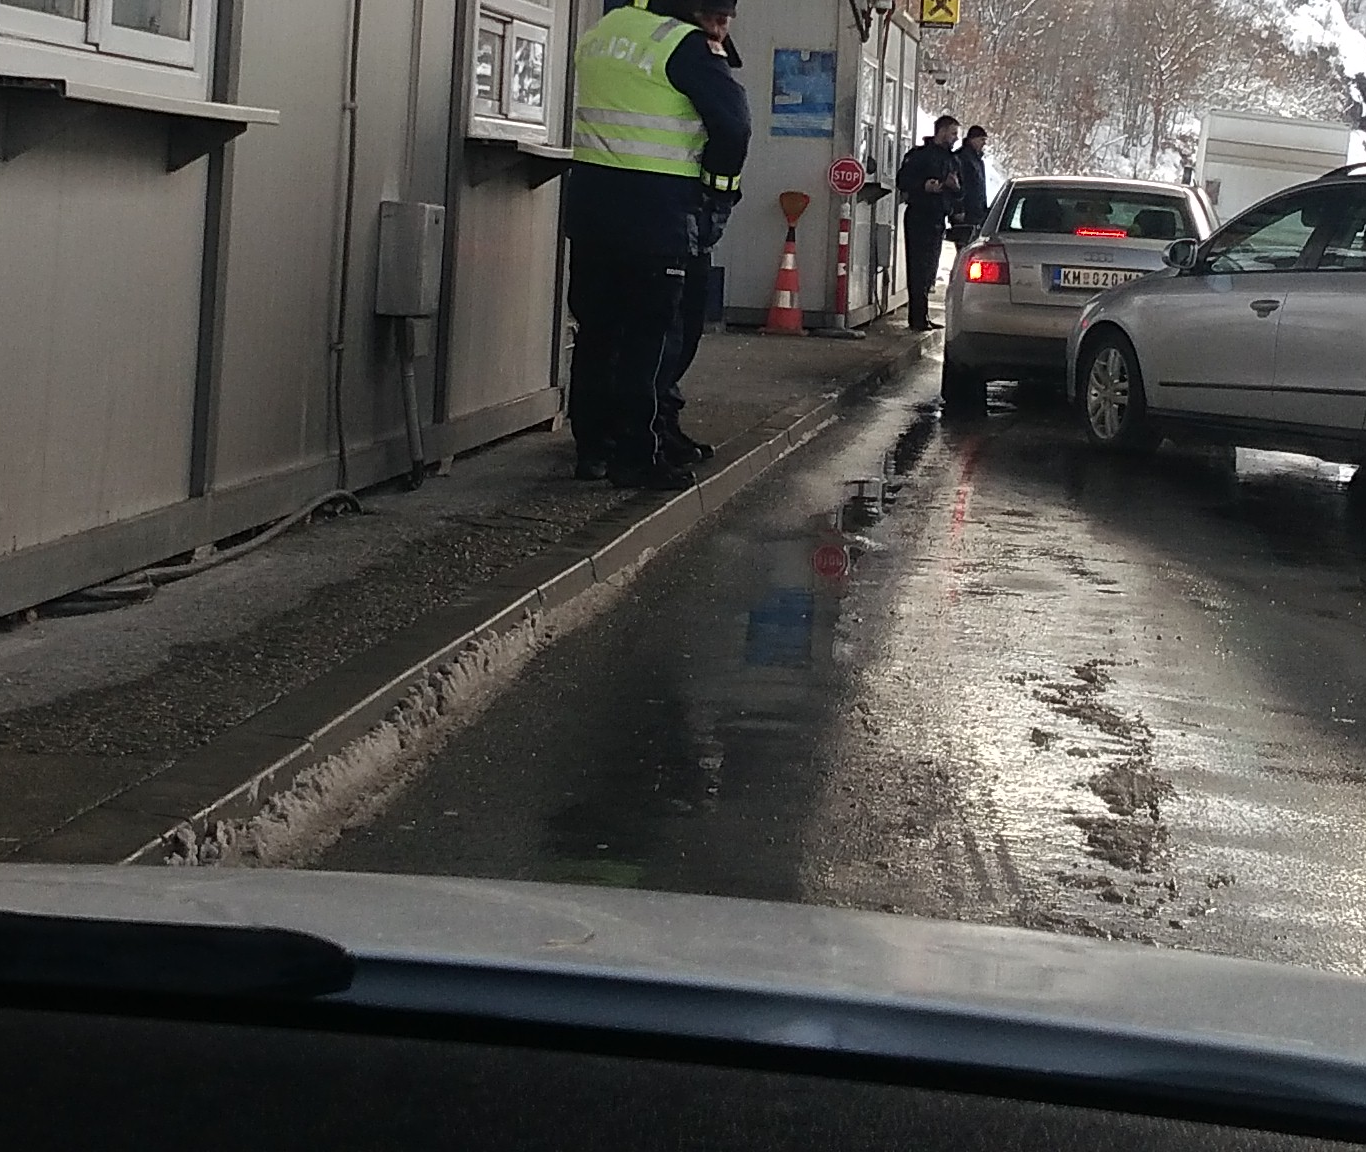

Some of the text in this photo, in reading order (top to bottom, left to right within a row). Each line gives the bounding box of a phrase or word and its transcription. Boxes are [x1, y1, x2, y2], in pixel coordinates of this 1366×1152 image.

[834, 170, 860, 182] STOP
[1063, 270, 1141, 286] KM 020-M
